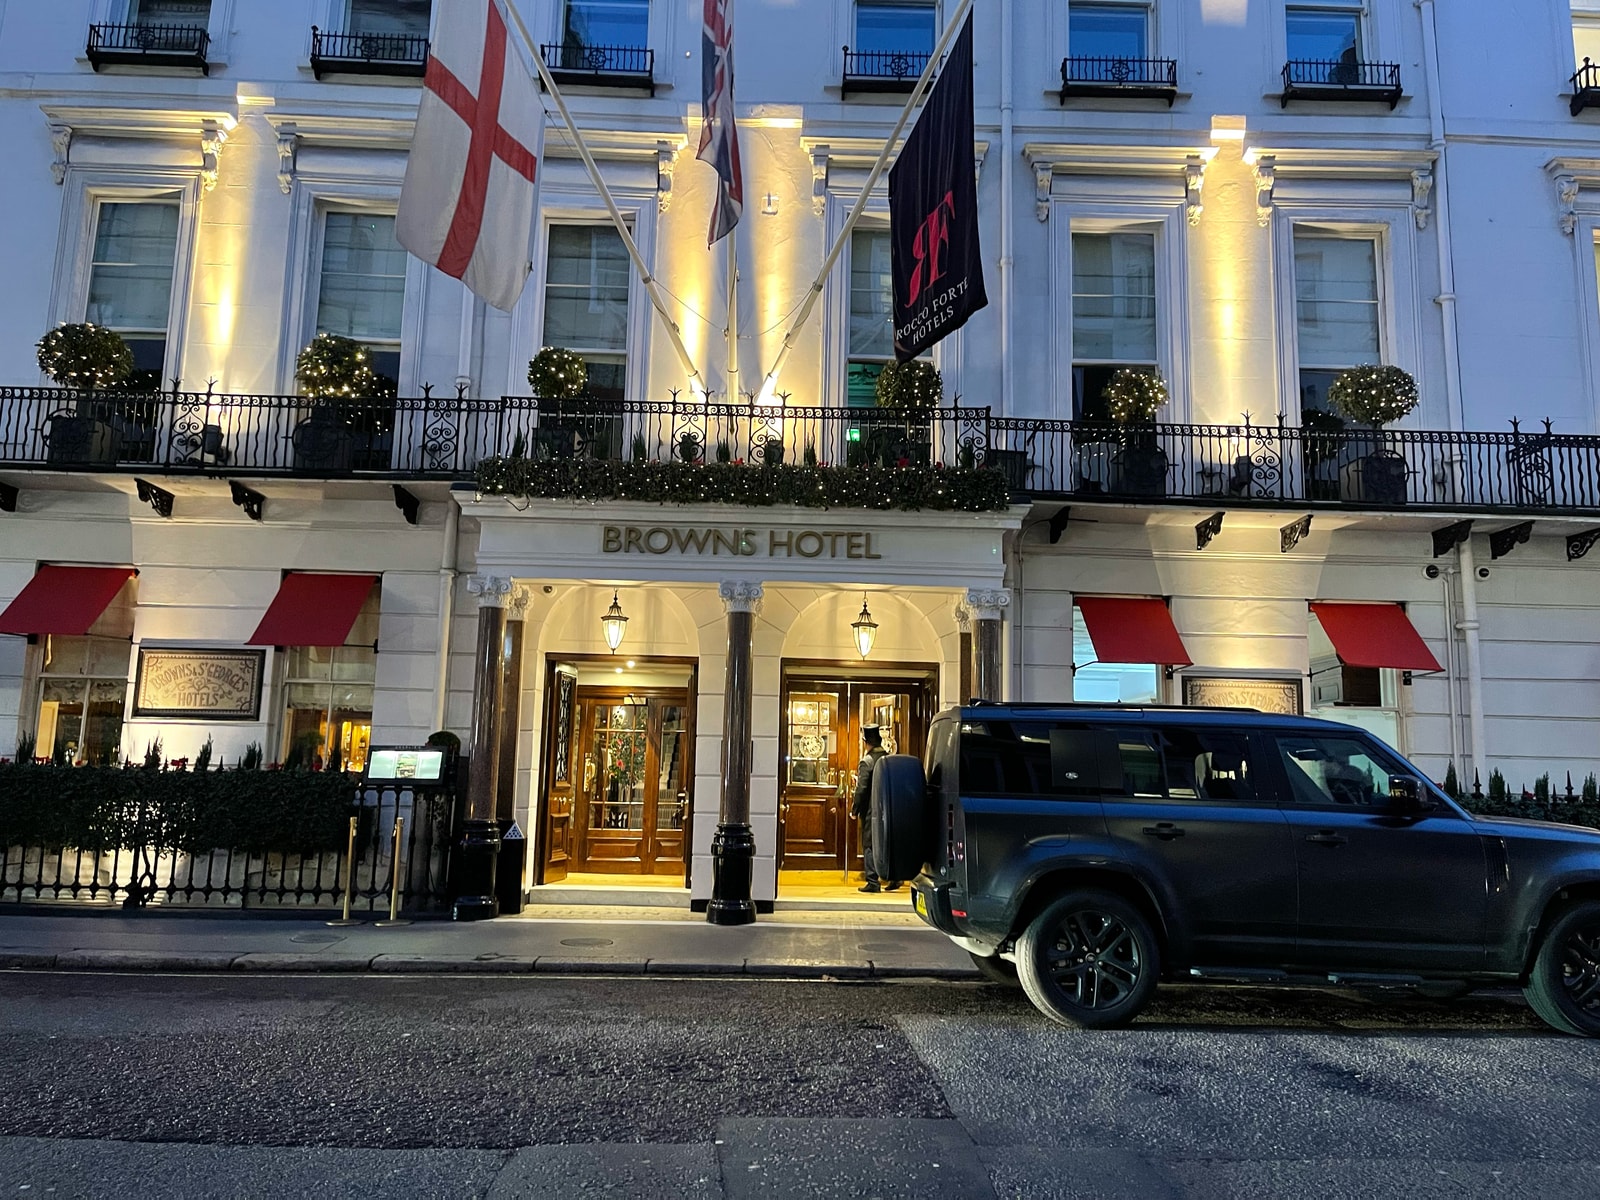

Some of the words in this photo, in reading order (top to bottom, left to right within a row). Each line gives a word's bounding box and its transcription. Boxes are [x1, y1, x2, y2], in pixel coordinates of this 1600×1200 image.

[896, 306, 929, 341] ROCCO
[912, 305, 954, 345] HOTELS
[602, 526, 756, 556] BROWNS
[769, 530, 882, 559] HOTEL
[177, 692, 219, 707] HOTELS
